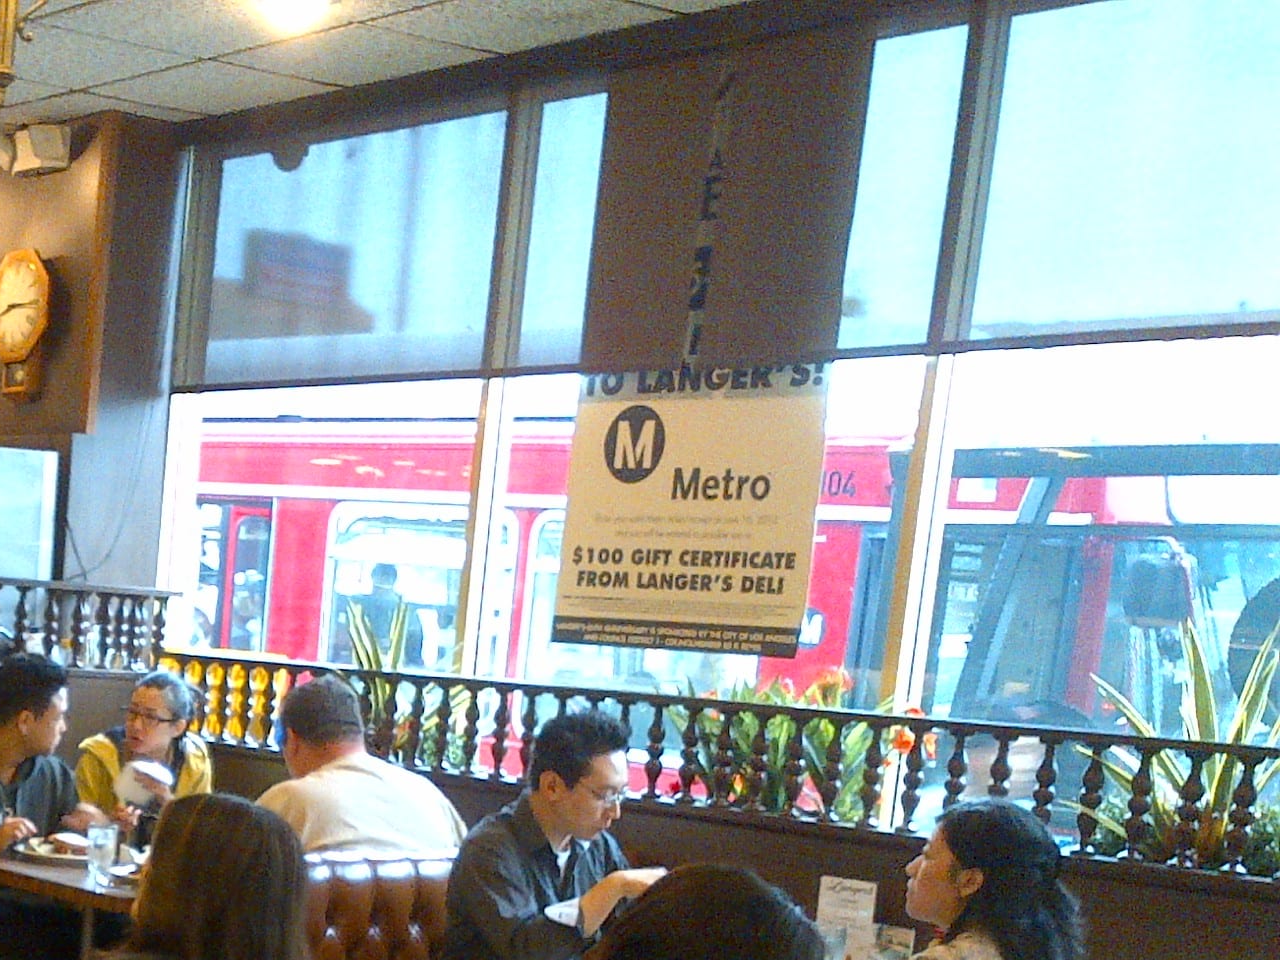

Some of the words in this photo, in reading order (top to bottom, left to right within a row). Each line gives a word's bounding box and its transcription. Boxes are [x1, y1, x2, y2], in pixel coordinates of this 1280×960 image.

[671, 467, 771, 501] Metro
[572, 545, 625, 566] $100
[631, 548, 673, 567] GIFT
[679, 550, 797, 571] CERTIFICATE
[576, 570, 629, 590] FROM
[636, 573, 733, 594] LANGER'S
[741, 576, 785, 596] DELI
